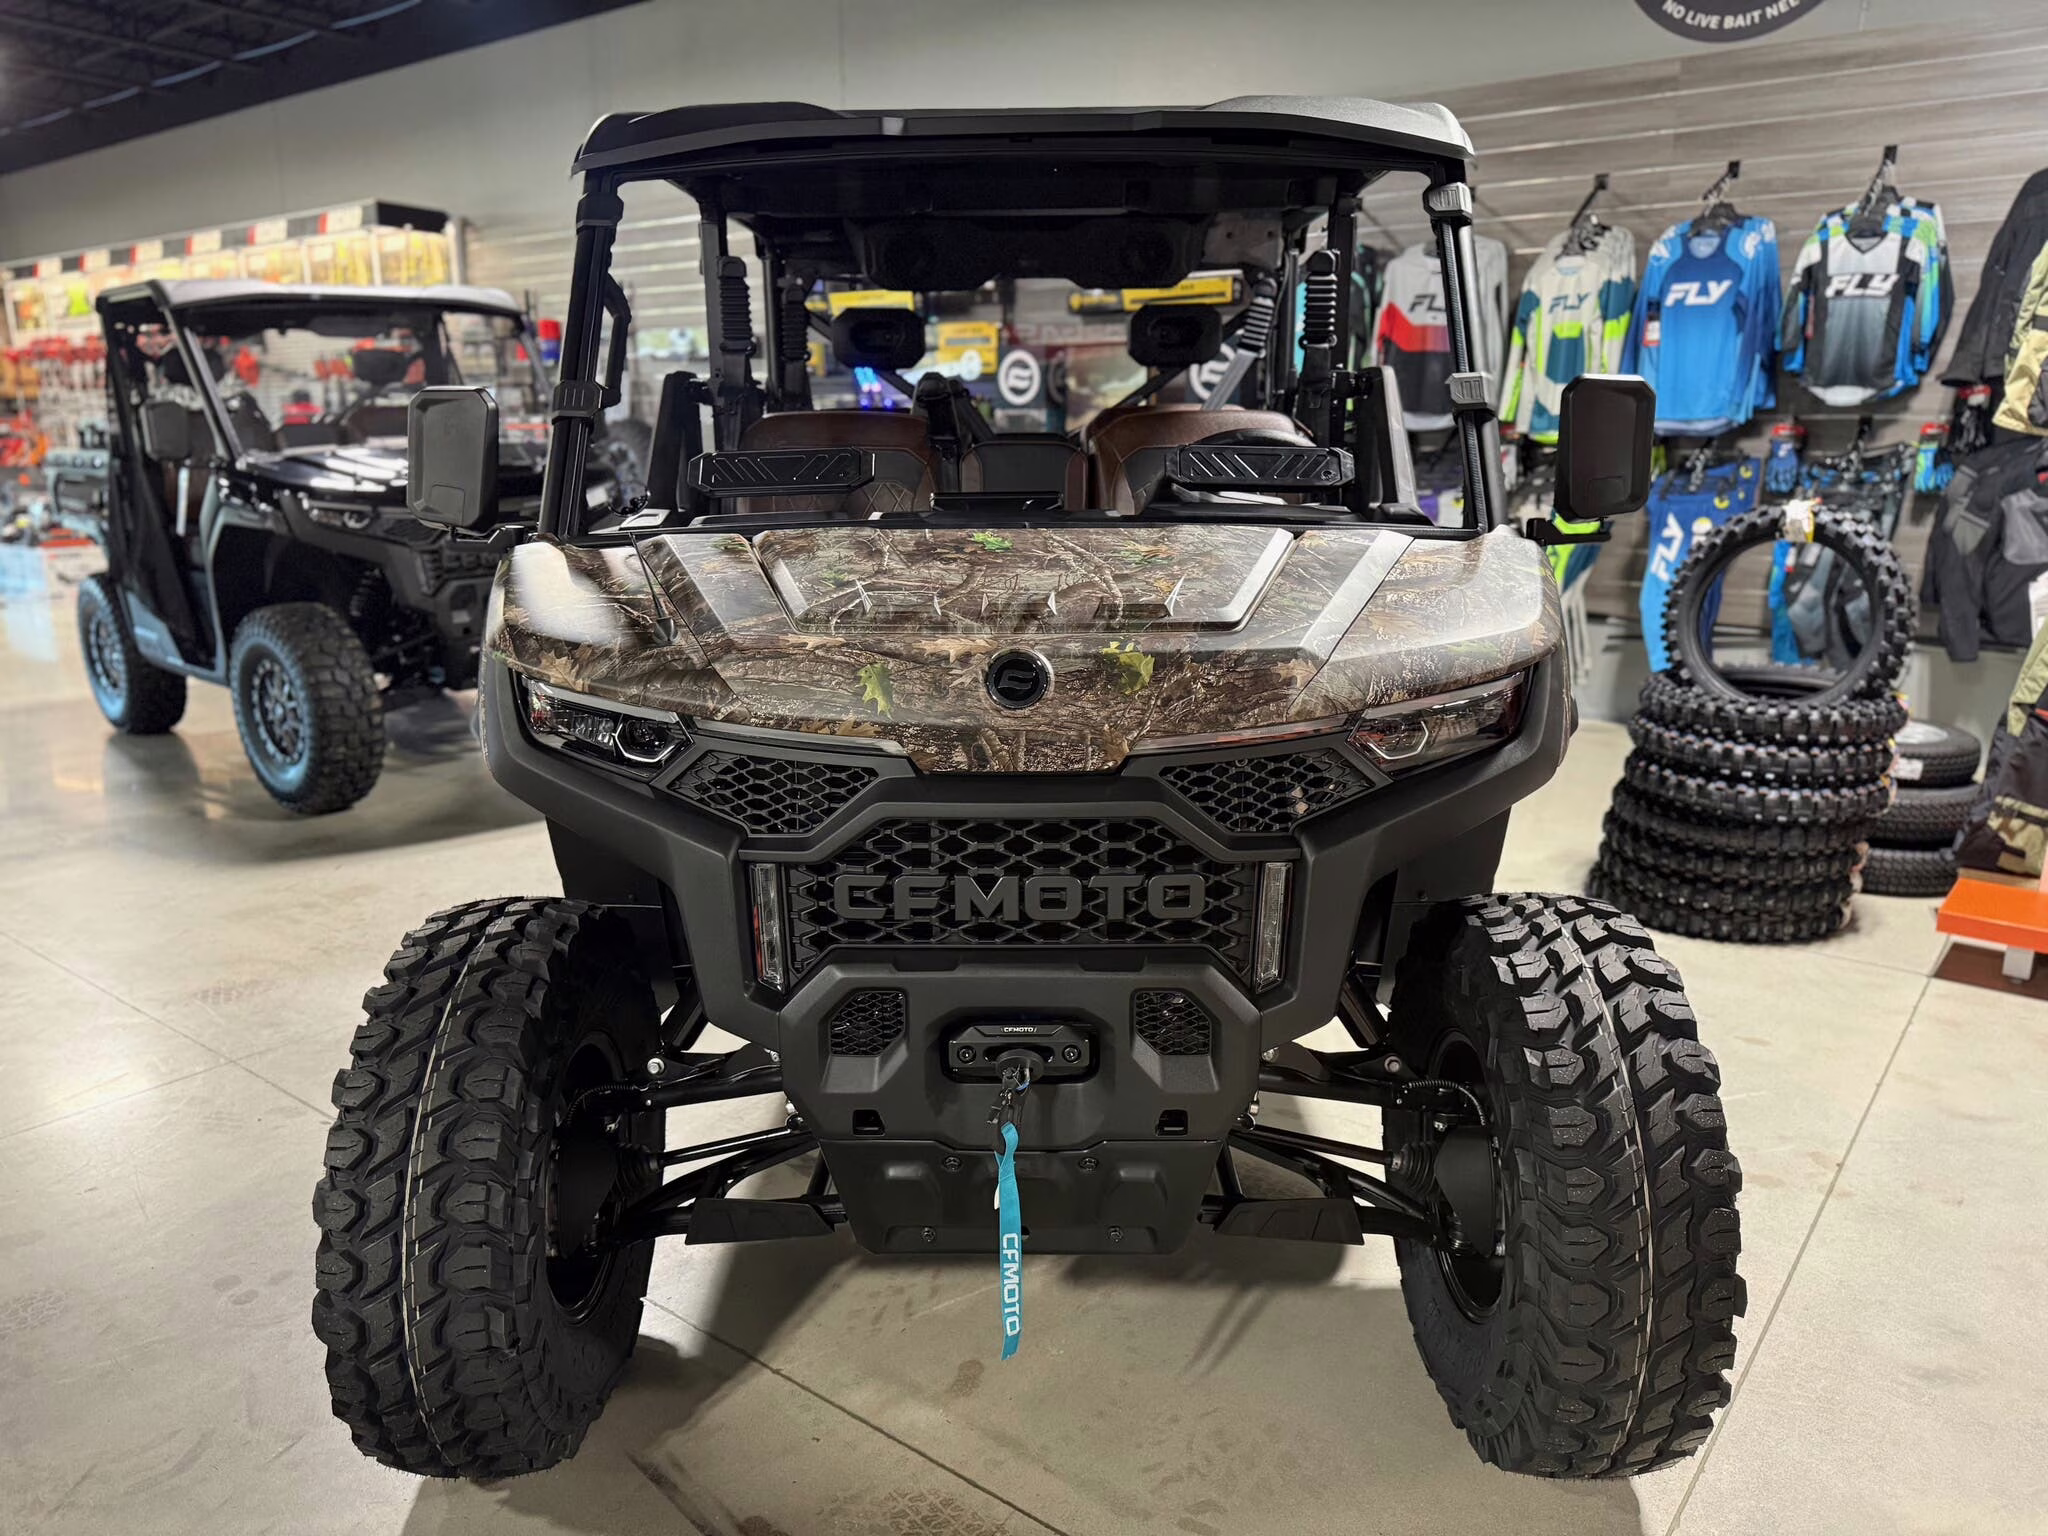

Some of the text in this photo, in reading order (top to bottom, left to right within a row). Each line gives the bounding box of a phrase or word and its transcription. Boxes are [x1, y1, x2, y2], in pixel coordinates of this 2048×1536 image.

[1662, 0, 1686, 19] NO
[1685, 11, 1721, 30] LIVE
[1723, 9, 1762, 30] BAIT
[1664, 279, 1733, 307] FLY
[1825, 273, 1900, 298] FLY
[1407, 294, 1446, 313] FL
[1548, 292, 1592, 315] FLY
[1651, 511, 1684, 581] FLY
[833, 874, 1206, 921] CFMOTO
[1003, 1233, 1020, 1337] CFMOTO
